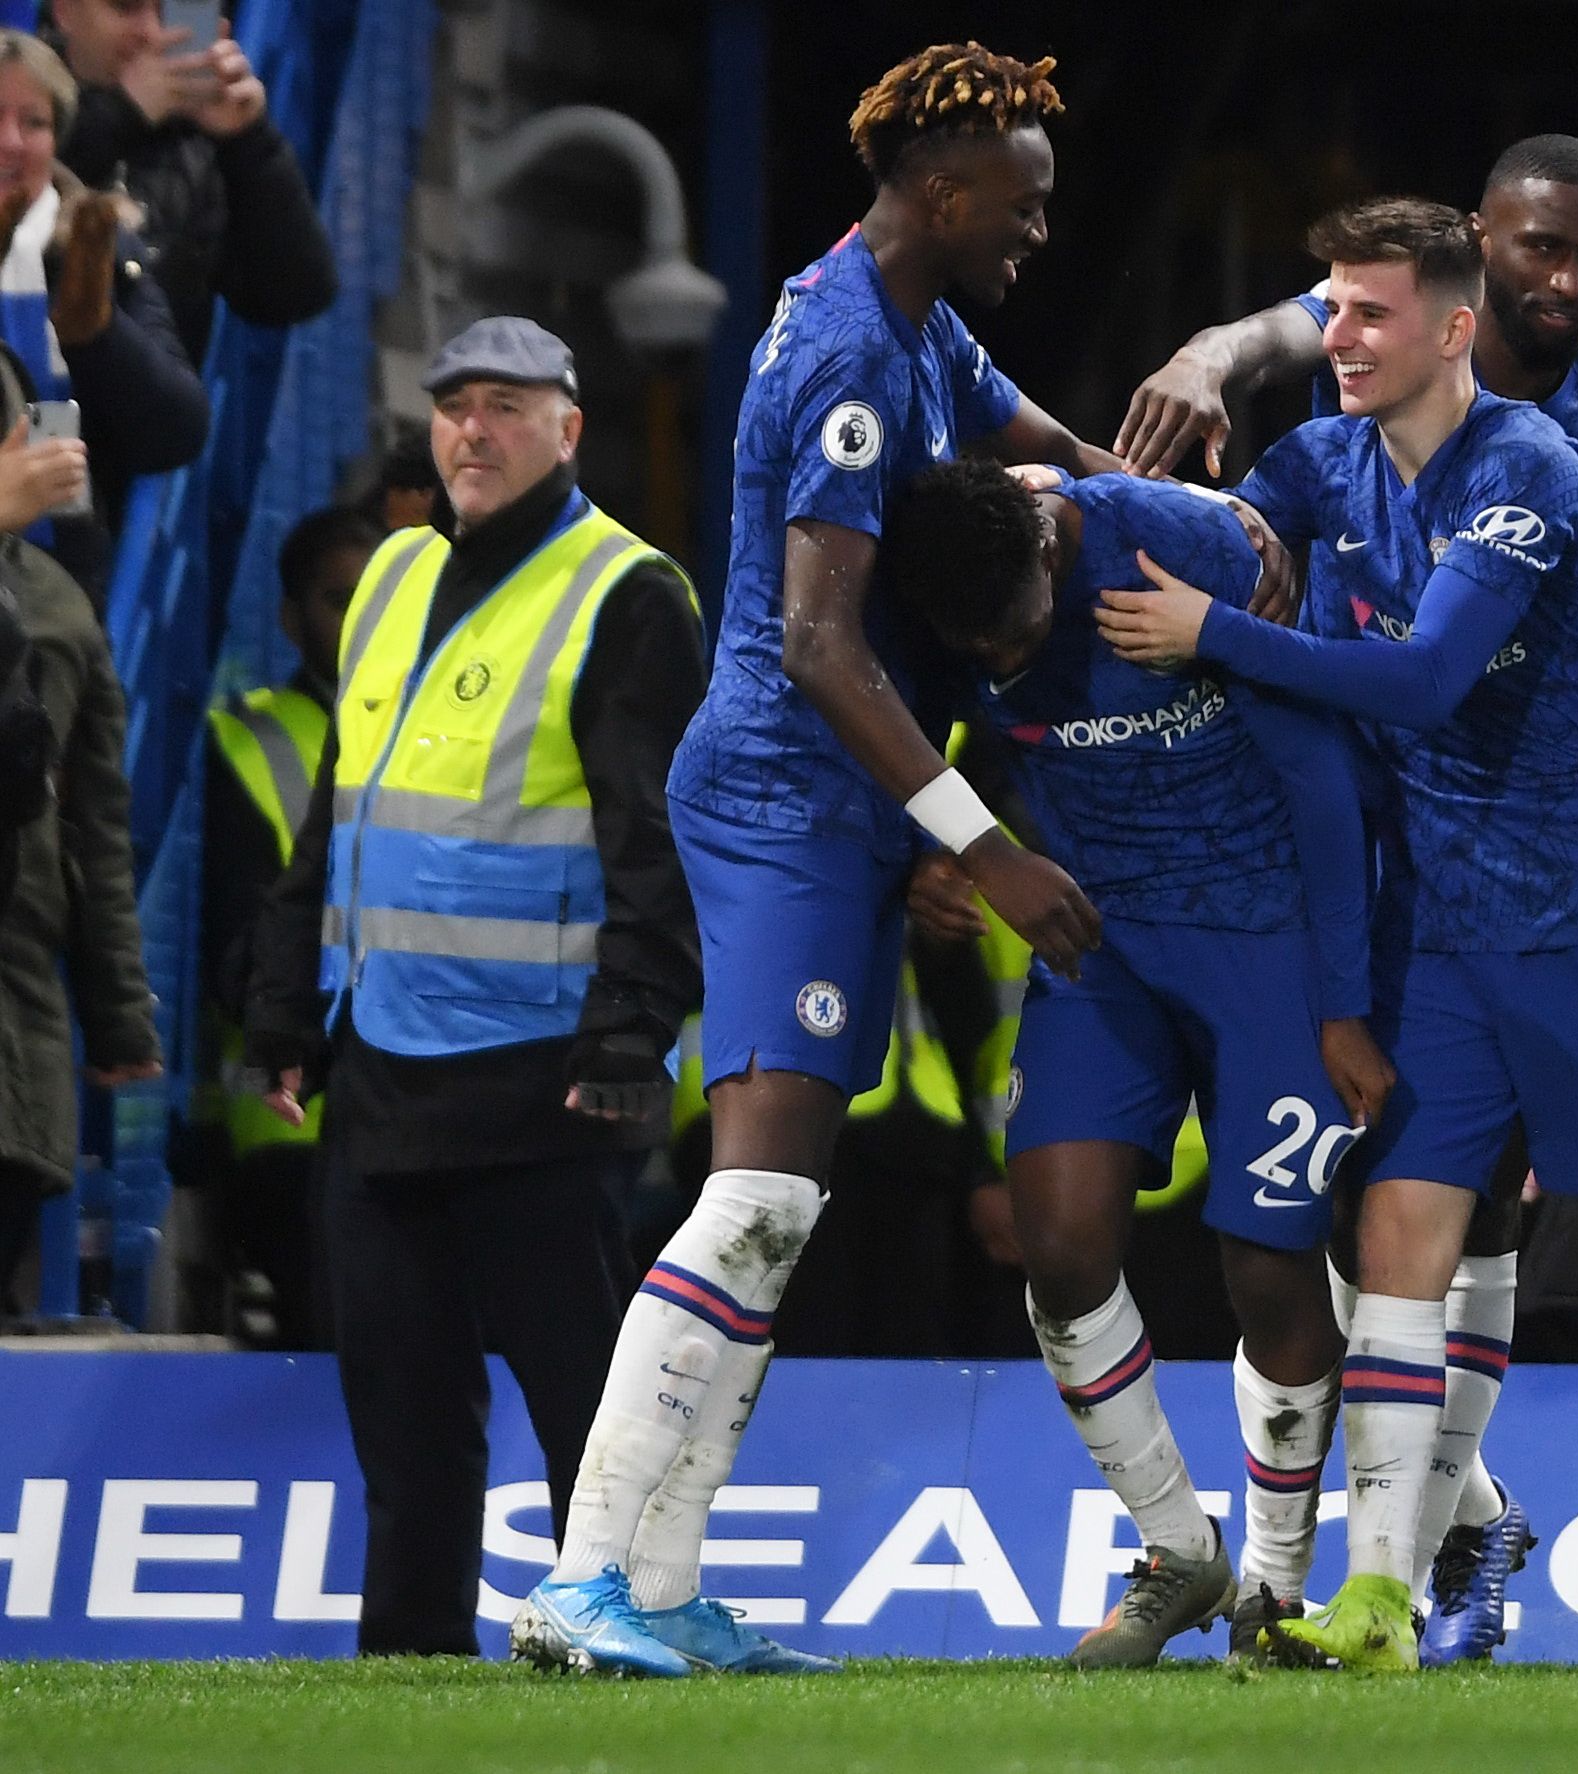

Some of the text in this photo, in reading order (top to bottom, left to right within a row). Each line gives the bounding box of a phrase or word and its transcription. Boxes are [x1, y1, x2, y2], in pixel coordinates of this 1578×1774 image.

[1160, 693, 1225, 749] TYRES
[1246, 1095, 1367, 1195] 20
[657, 1392, 694, 1420] CFC
